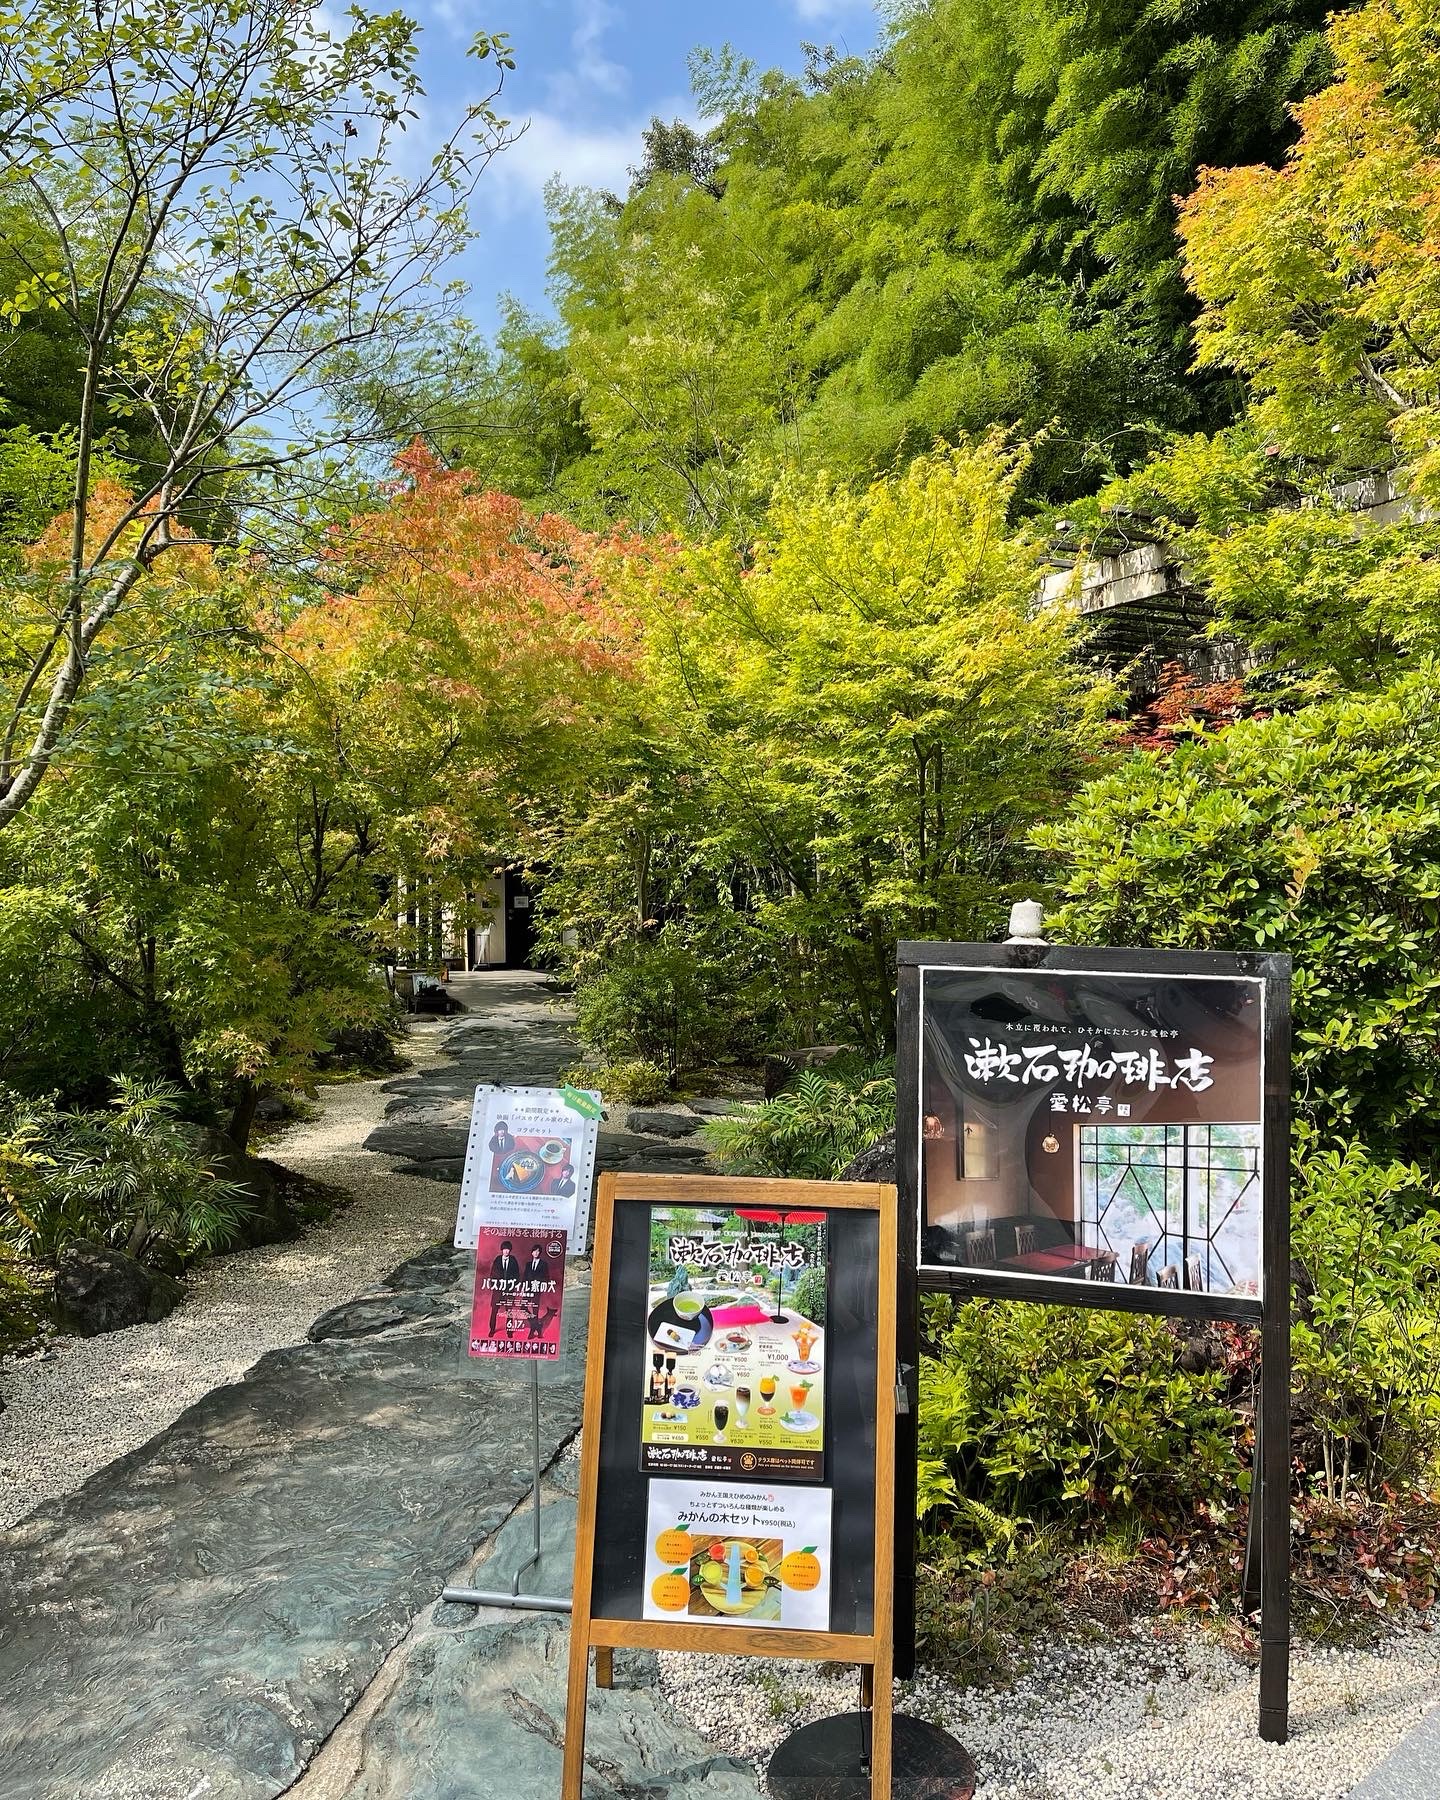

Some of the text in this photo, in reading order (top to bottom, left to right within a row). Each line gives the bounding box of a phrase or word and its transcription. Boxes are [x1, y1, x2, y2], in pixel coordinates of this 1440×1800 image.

[964, 1037, 1215, 1092] 漱石珈琲店
[1050, 1093, 1113, 1115] 愛松亭
[670, 1237, 804, 1268] 漱石珈琲店
[481, 1278, 557, 1293] バスカヴィル家の犬
[506, 1319, 523, 1329] 6.17
[647, 1446, 708, 1462] 漱石珈琲店
[700, 1491, 768, 1501] みかん王国えひめのみかん
[678, 1511, 760, 1525] みかんの木セット
